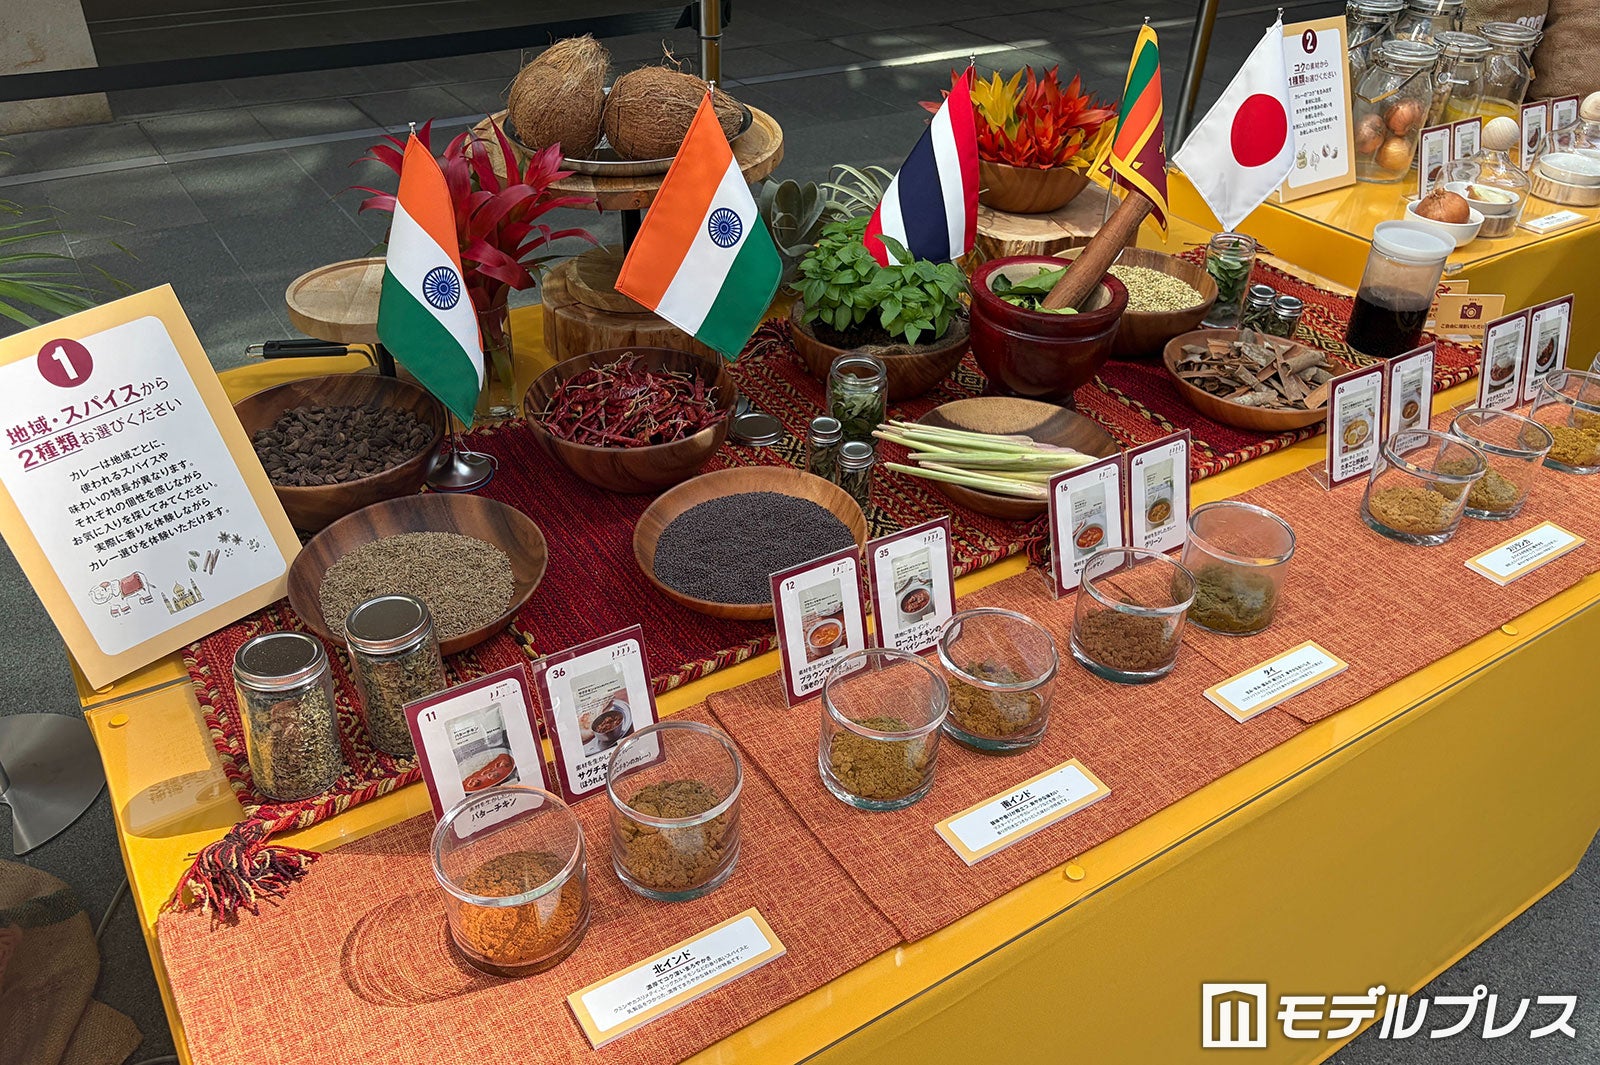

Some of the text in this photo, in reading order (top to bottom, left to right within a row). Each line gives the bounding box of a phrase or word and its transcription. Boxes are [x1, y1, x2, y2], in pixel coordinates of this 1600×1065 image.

[1306, 32, 1314, 50] 2
[1294, 60, 1329, 73] コクの素材から
[1288, 71, 1337, 87] 1種類お選びください
[51, 345, 79, 381] 1
[6, 376, 169, 445] 地域・スパイスから
[18, 398, 182, 469] 2種類お選びください
[69, 439, 166, 482] カレーは地域ごとに、
[80, 451, 169, 494] 使われるスパイスや
[1134, 458, 1144, 466] 44
[68, 459, 194, 516] 味わいの特長が異なります。
[74, 470, 202, 528] それぞれの個性を感じながら
[1060, 484, 1068, 492] 16
[71, 481, 218, 547] お気に入りを探してみてください。
[94, 497, 211, 554] 実際に香りを体験しながら
[89, 506, 230, 572] カレー選びを体験いただけます。
[1144, 536, 1163, 548] グリーン
[879, 549, 889, 558] 35
[785, 581, 795, 590] 12
[895, 624, 942, 648] ローストチキンの
[899, 634, 940, 651] パイシーカレー
[552, 668, 566, 679] 36
[426, 712, 437, 722] 11
[472, 798, 516, 822] バターチキン
[1000, 790, 1031, 809] 南インド
[646, 955, 712, 990] 濃厚でコク深いまろやかさ
[652, 949, 691, 975] 北インド
